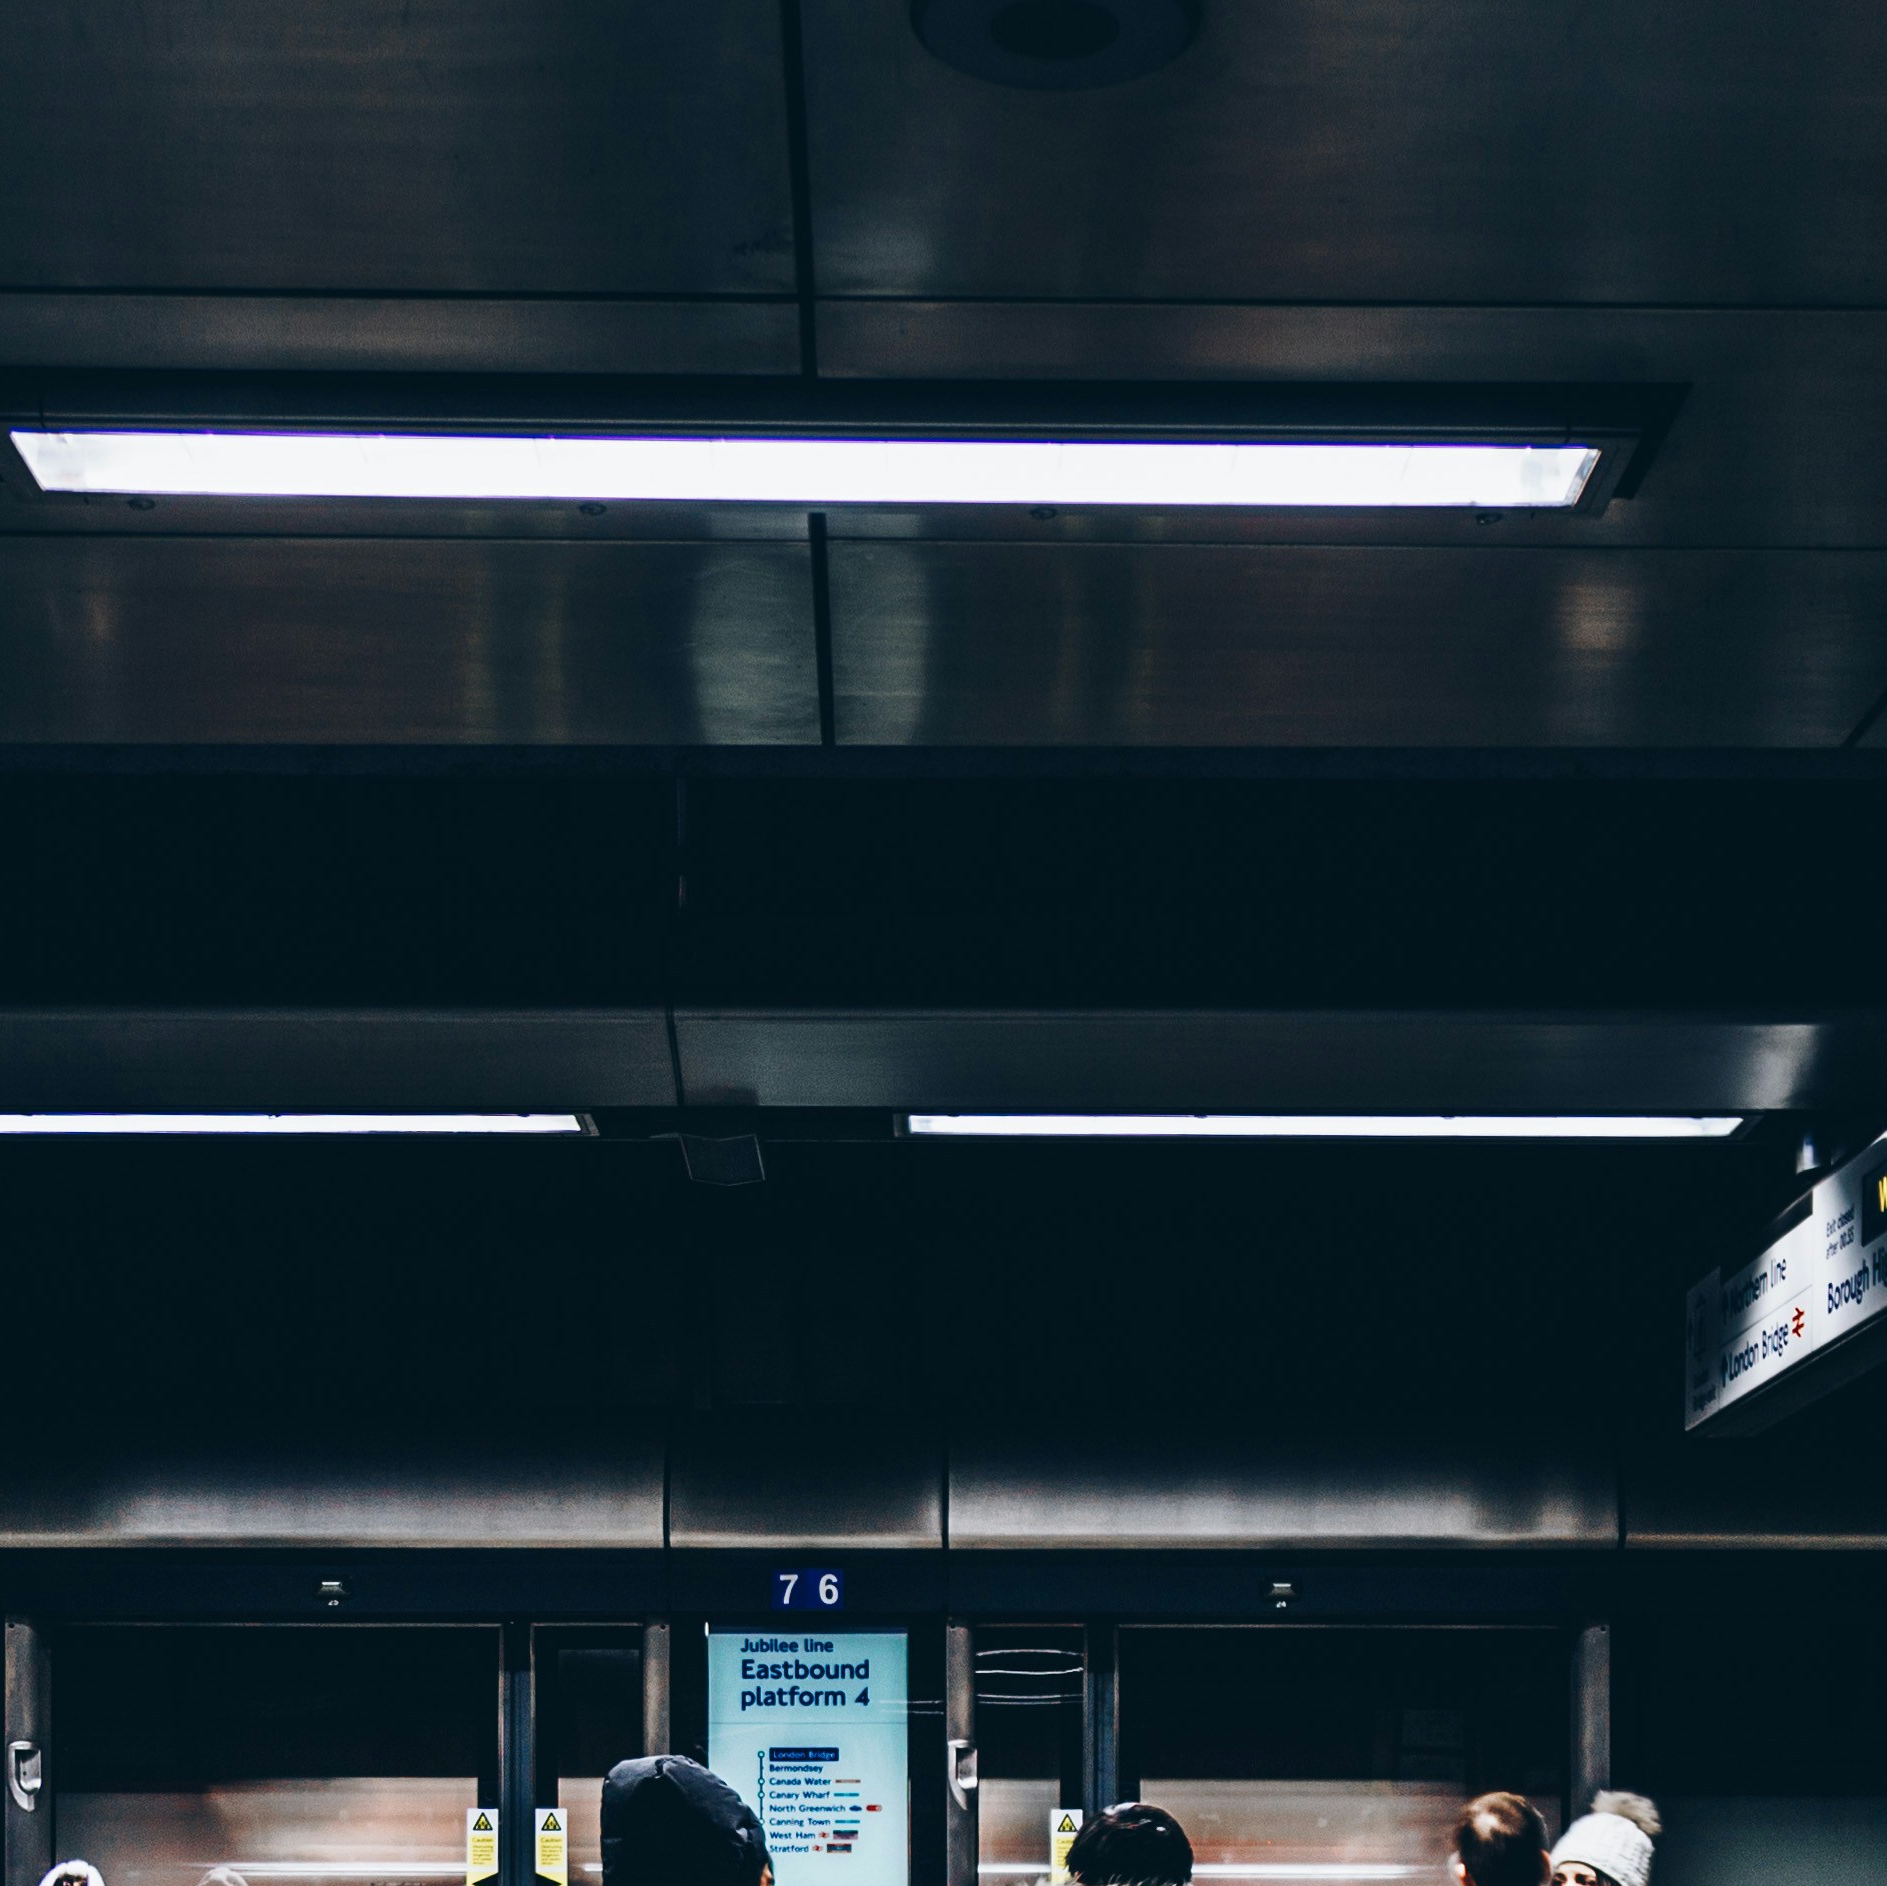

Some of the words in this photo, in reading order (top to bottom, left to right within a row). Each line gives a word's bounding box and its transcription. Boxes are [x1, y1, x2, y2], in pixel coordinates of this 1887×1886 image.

[1729, 1271, 1768, 1319] Northern
[1771, 1257, 1786, 1287] line
[1828, 1259, 1870, 1314] Borough
[1729, 1340, 1760, 1381] London
[1762, 1320, 1789, 1358] Bridge
[779, 1574, 799, 1605] 7
[818, 1573, 839, 1605] 6
[740, 1638, 799, 1653] Jubilee
[803, 1638, 834, 1653] line
[741, 1658, 870, 1680] Eastbound
[741, 1685, 846, 1712] platform
[854, 1686, 871, 1706] 4
[773, 1751, 806, 1759] London
[808, 1751, 835, 1760] Bridge
[769, 1764, 823, 1774] Bermondsey
[769, 1777, 802, 1785] Canada
[769, 1791, 799, 1800] Canary
[802, 1791, 830, 1799] Wharf
[769, 1804, 796, 1812] North
[799, 1804, 845, 1812] Greenwich
[769, 1818, 804, 1827] Canning
[808, 1818, 831, 1826] Town
[769, 1845, 809, 1853] Stratford
